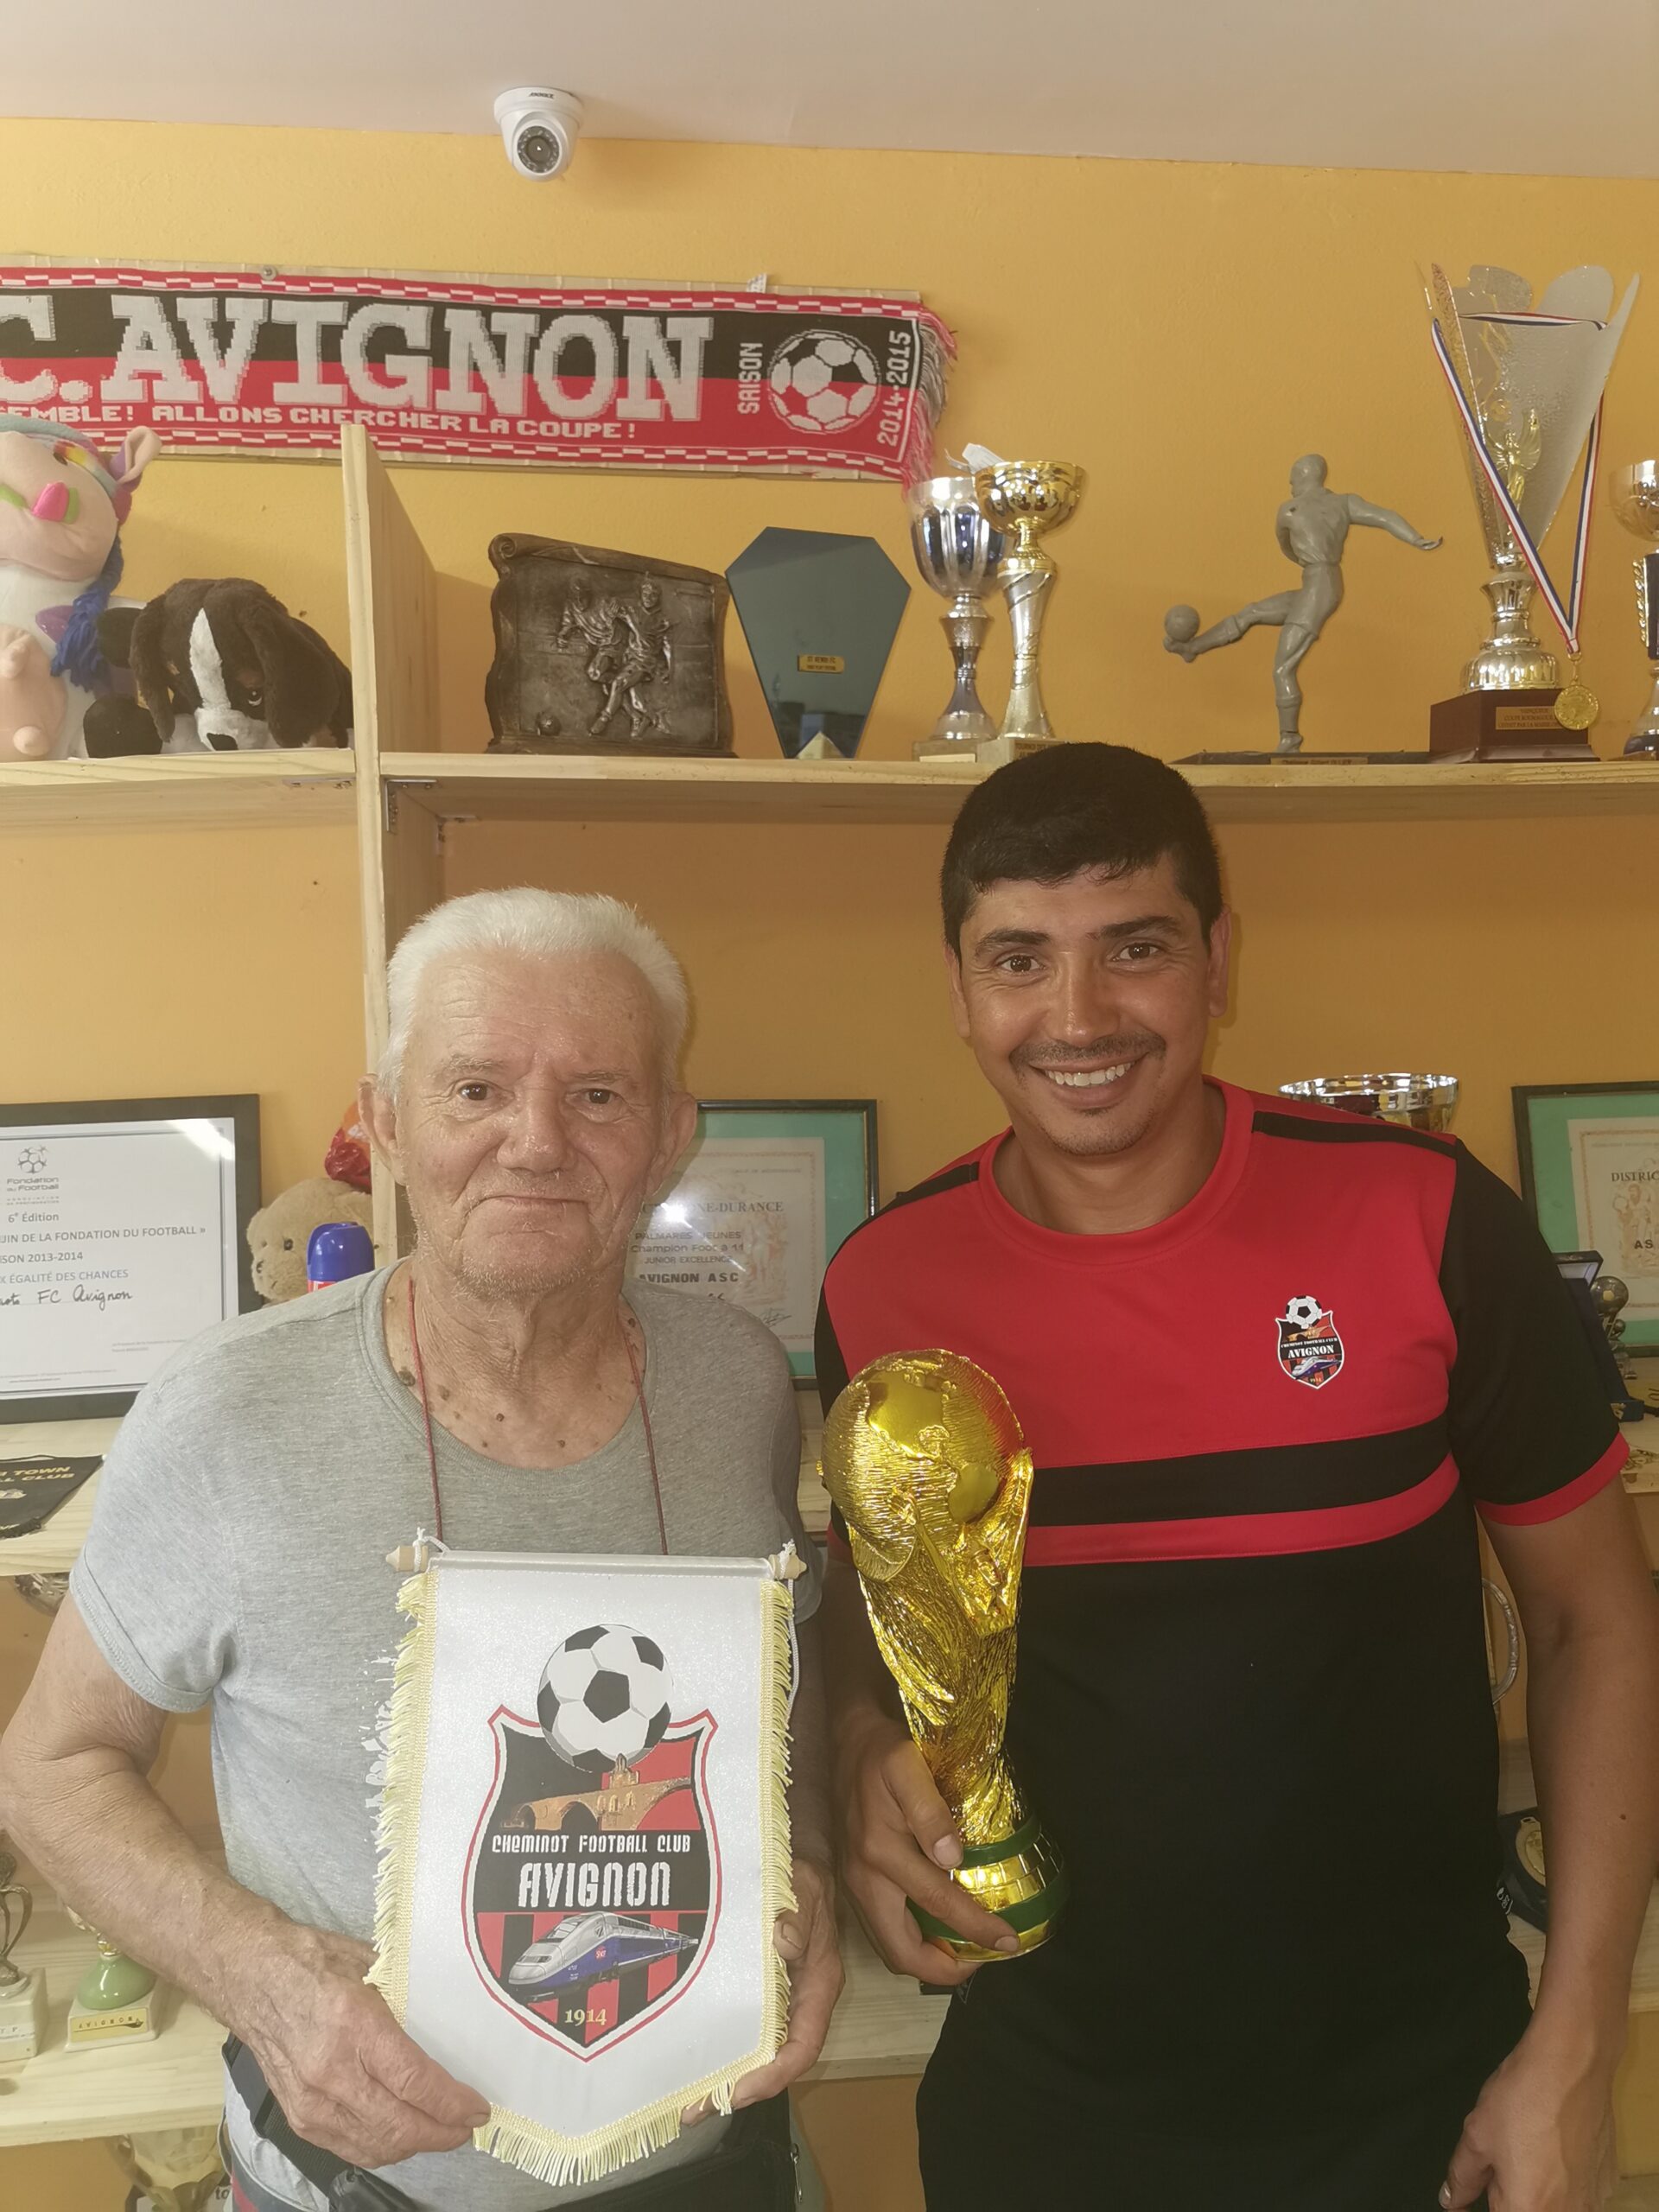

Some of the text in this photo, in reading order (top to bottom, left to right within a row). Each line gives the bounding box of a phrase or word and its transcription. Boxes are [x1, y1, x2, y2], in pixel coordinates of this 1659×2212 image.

[737, 342, 763, 414] SAISON
[152, 405, 283, 423] ALLONS
[290, 409, 462, 430] CHERCHER
[470, 417, 509, 434] LA
[683, 1199, 783, 1212] NE-DURANCE
[22, 1211, 59, 1222] Édition
[22, 1233, 35, 1243] DE
[39, 1232, 52, 1242] LA
[55, 1229, 120, 1241] FONDATION
[124, 1228, 138, 1238] DU
[143, 1226, 197, 1236] FOOTBALL
[631, 1243, 689, 1254] Champion
[28, 1252, 84, 1262] 2013-2014
[10, 1271, 53, 1284] ÉGALITÉ
[55, 1271, 76, 1281] DES
[79, 1269, 129, 1281] CHANCES
[37, 1288, 61, 1304] FC
[73, 1284, 133, 1311] Avignon
[1287, 1344, 1335, 1359] AVIGNON
[14, 1466, 71, 1475] TOWN
[578, 1834, 648, 1853] FOOTBALL
[657, 1834, 691, 1853] CLUB
[518, 1861, 671, 1908] AVIGNON
[564, 2008, 607, 2025] 1914
